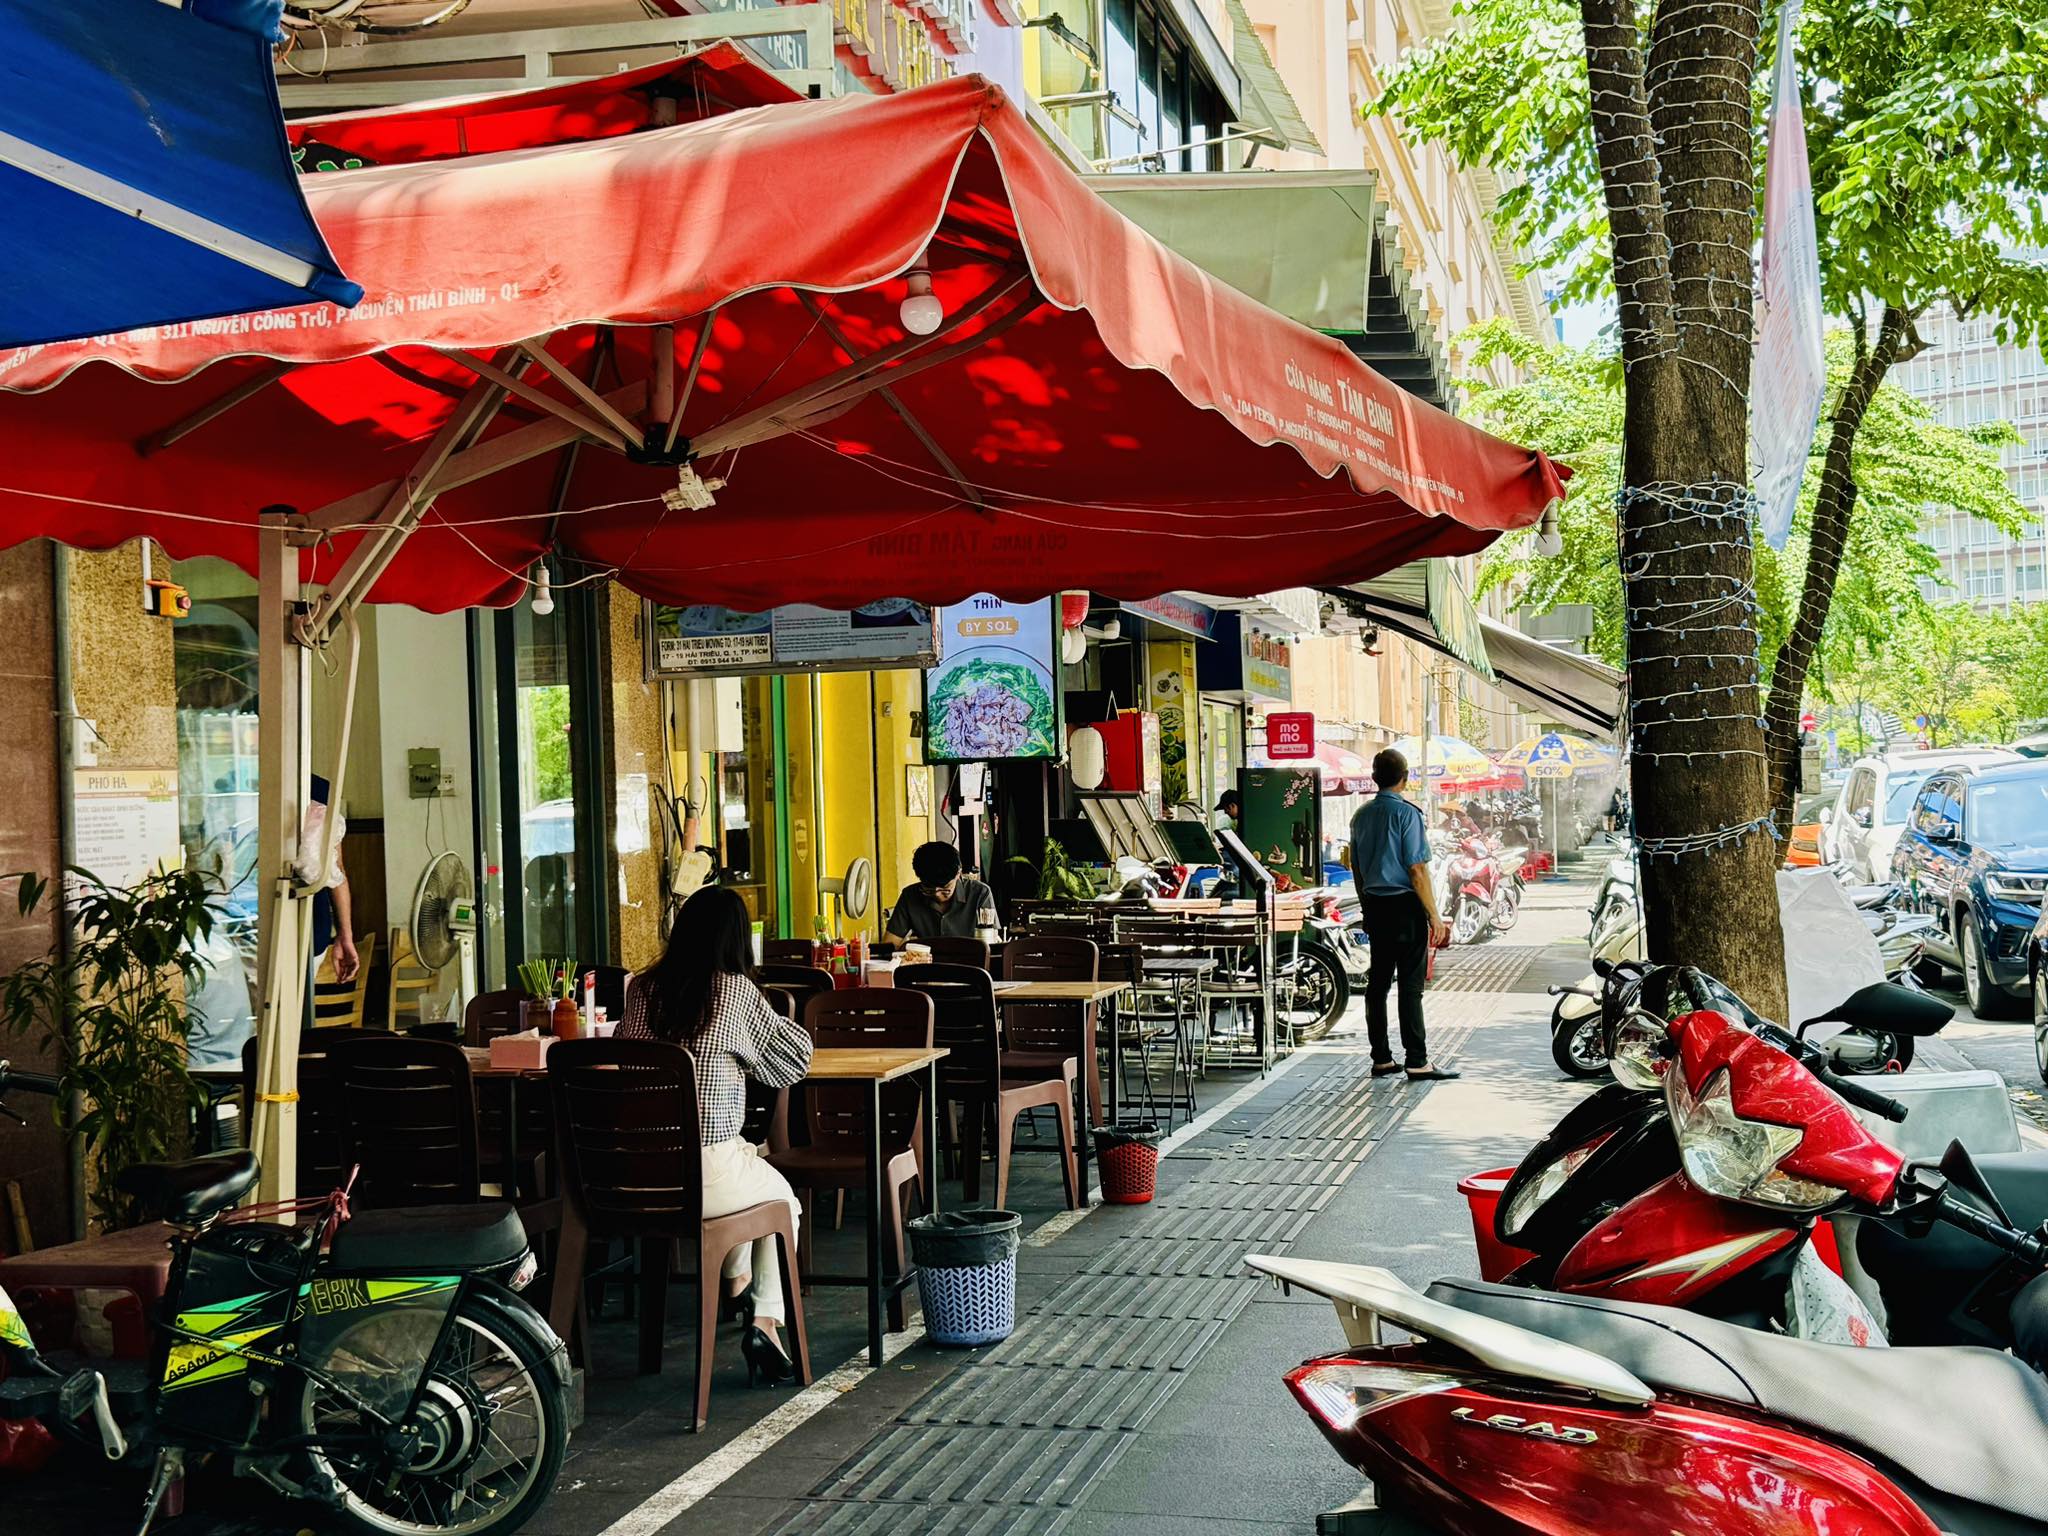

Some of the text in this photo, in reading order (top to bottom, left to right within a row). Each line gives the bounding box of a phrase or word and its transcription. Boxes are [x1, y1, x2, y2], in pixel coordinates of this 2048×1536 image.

[252, 310, 297, 332] CÔNG
[408, 287, 443, 312] THÁI
[447, 283, 486, 308] BÌNH
[500, 282, 521, 301] Q1
[966, 620, 1013, 632] BY SOL
[1535, 766, 1564, 776] 50%
[168, 1350, 217, 1380] ASAMA
[1451, 1397, 1599, 1444] LEAD
